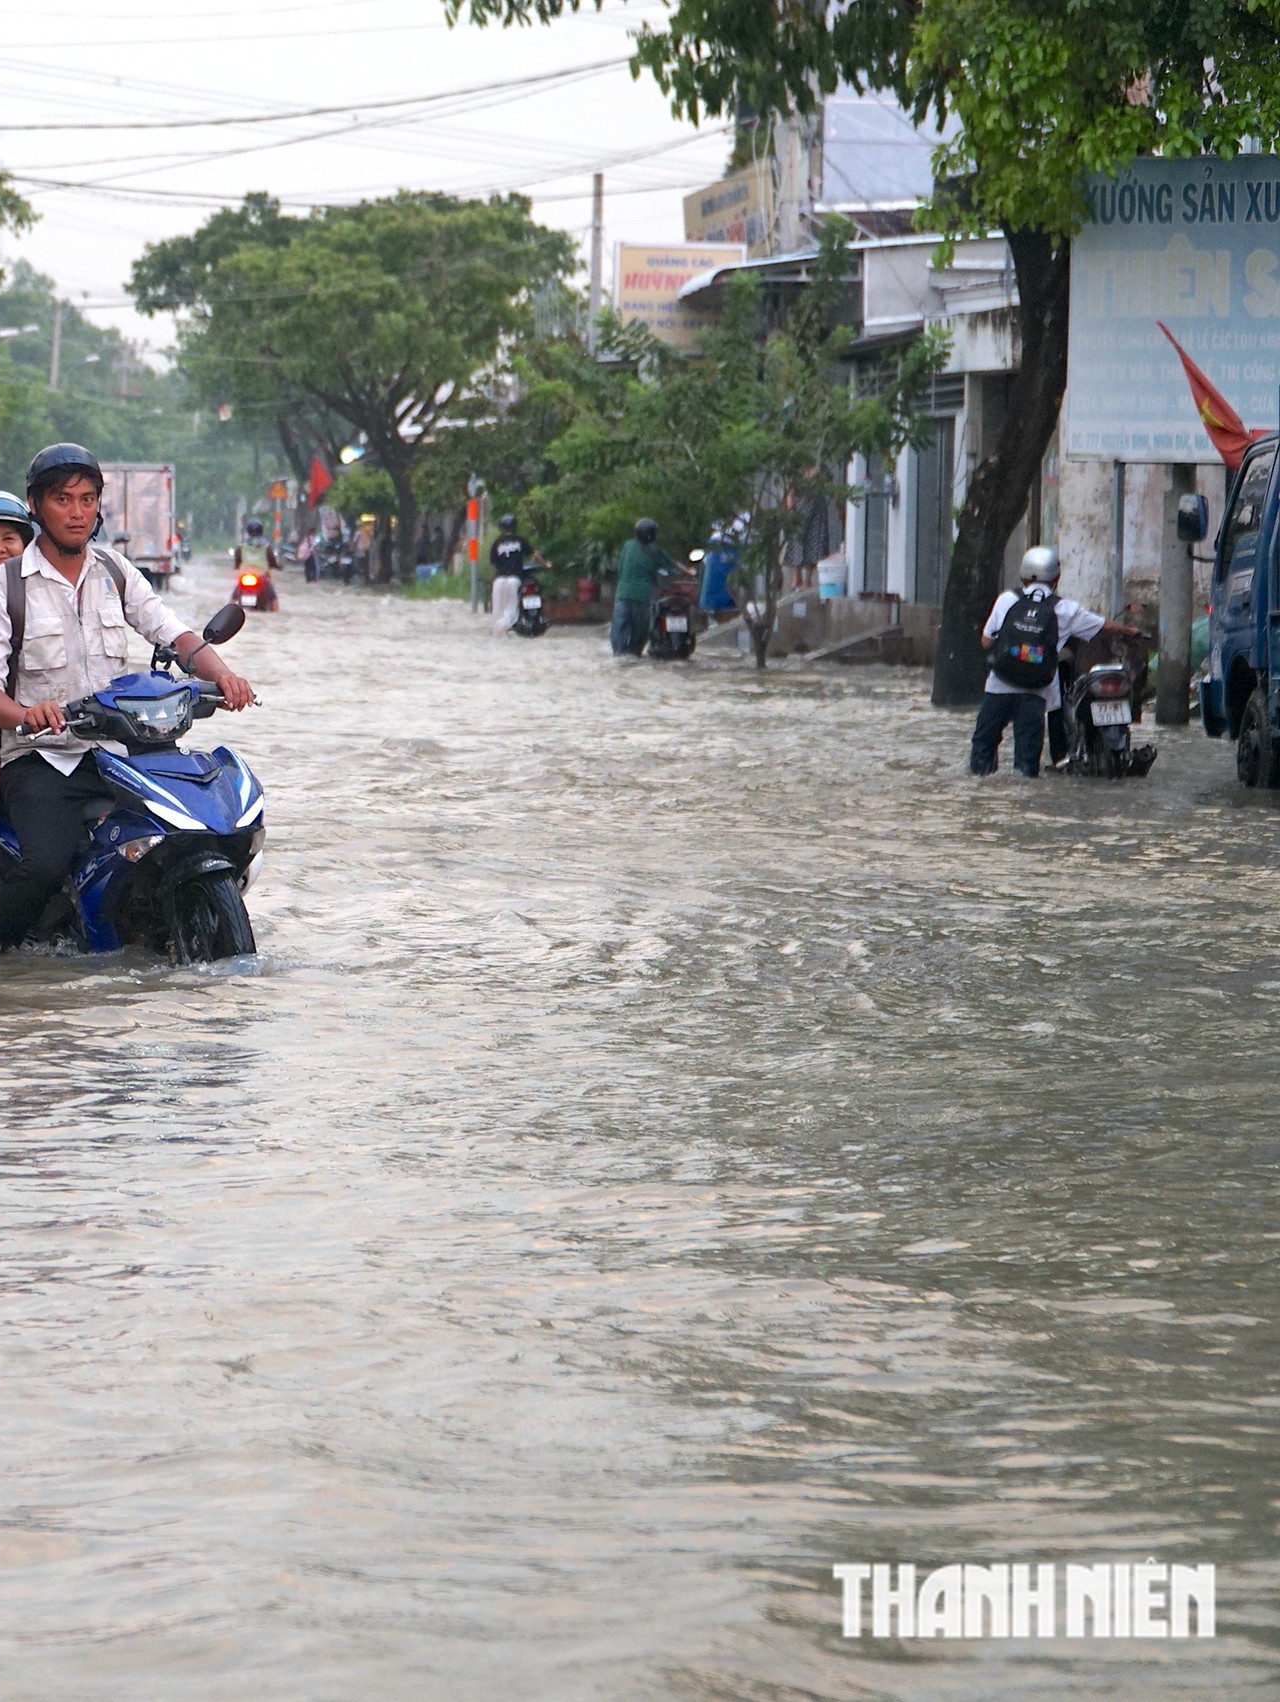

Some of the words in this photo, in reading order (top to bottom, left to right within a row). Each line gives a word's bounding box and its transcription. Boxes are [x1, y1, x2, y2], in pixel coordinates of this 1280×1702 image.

[1182, 166, 1235, 224] SẢN
[1081, 233, 1231, 317] THIÊN
[1243, 360, 1275, 382] CÔNG
